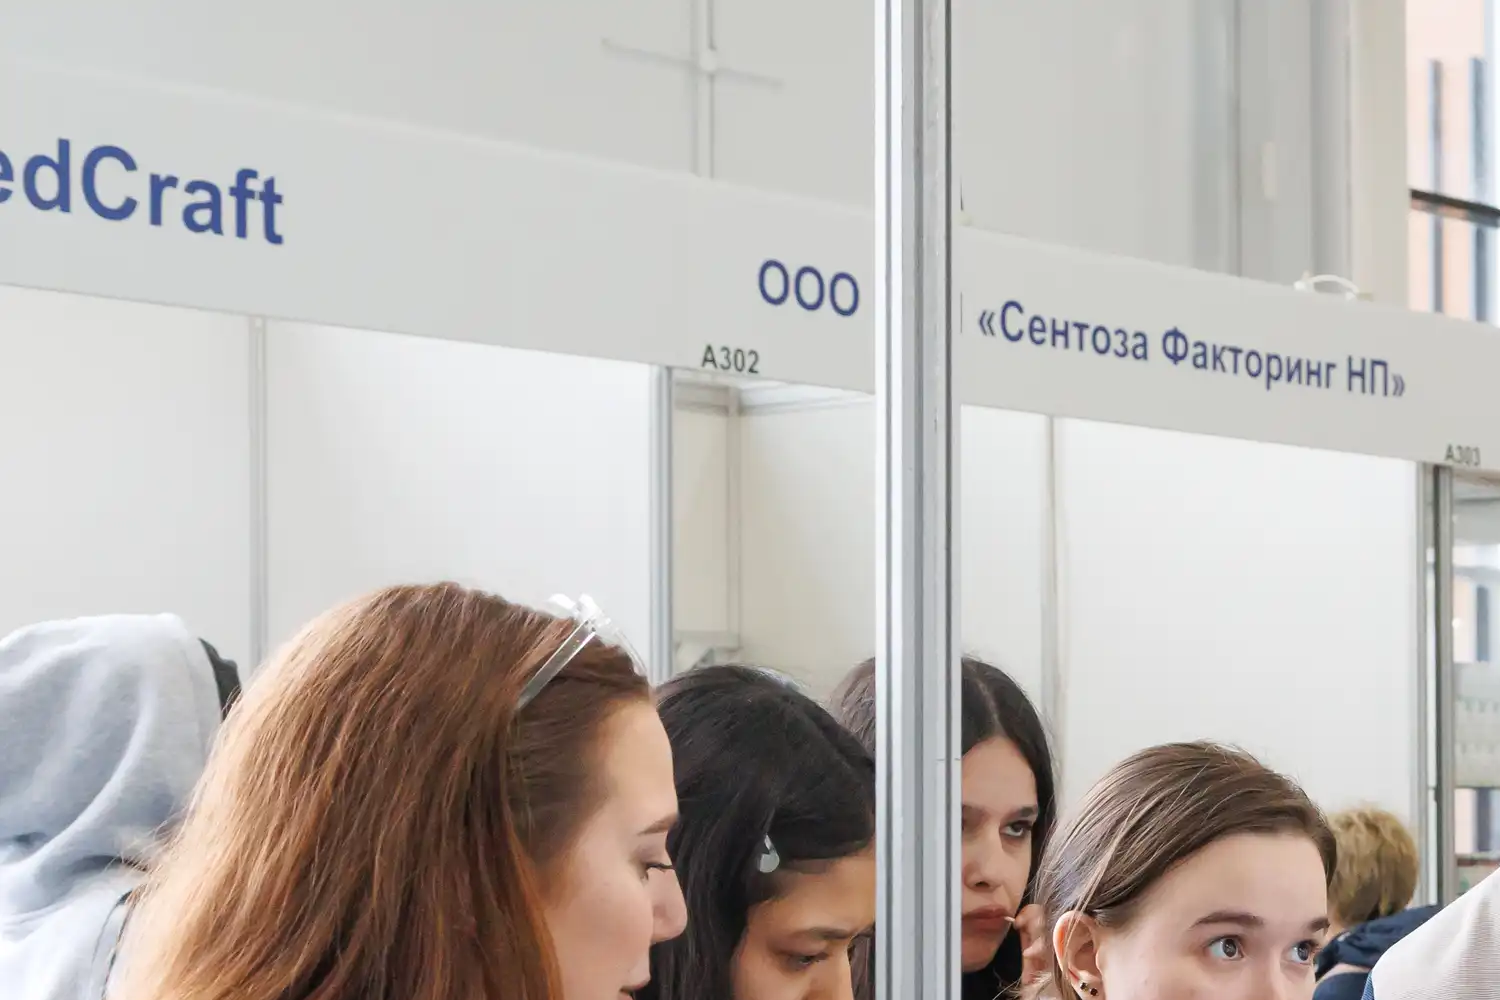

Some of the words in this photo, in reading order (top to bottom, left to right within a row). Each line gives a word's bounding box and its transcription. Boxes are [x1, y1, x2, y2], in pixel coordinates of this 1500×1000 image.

[701, 343, 760, 374] A302
[978, 300, 1149, 362] «Сентоза
[1161, 326, 1337, 391] Факторинг
[1347, 355, 1406, 398] НП»
